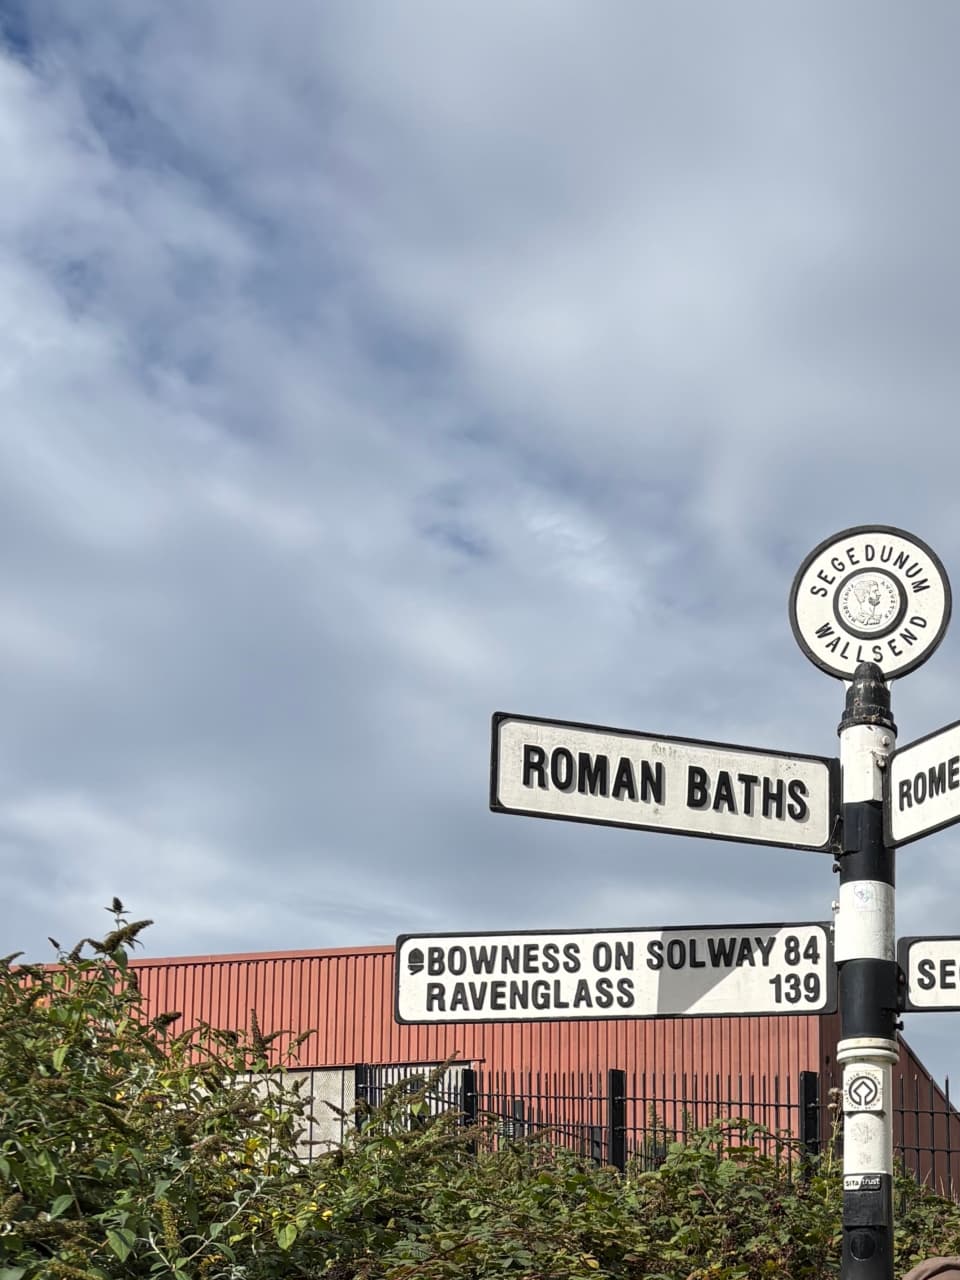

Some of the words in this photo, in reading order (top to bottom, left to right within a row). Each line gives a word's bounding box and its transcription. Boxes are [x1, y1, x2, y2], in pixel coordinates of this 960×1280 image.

[810, 544, 931, 597] SEGEDUNUM
[815, 615, 928, 663] WALLSEND
[523, 744, 666, 804] ROMAN
[686, 765, 810, 822] BATHS
[898, 755, 960, 813] ROME
[427, 943, 582, 977] BOWNESS
[593, 941, 635, 971] ON
[646, 935, 777, 970] SOLWAY
[784, 934, 821, 966] 84
[426, 977, 635, 1012] RAVENGLASS
[769, 972, 821, 1004] 139
[862, 1177, 881, 1185] trust
